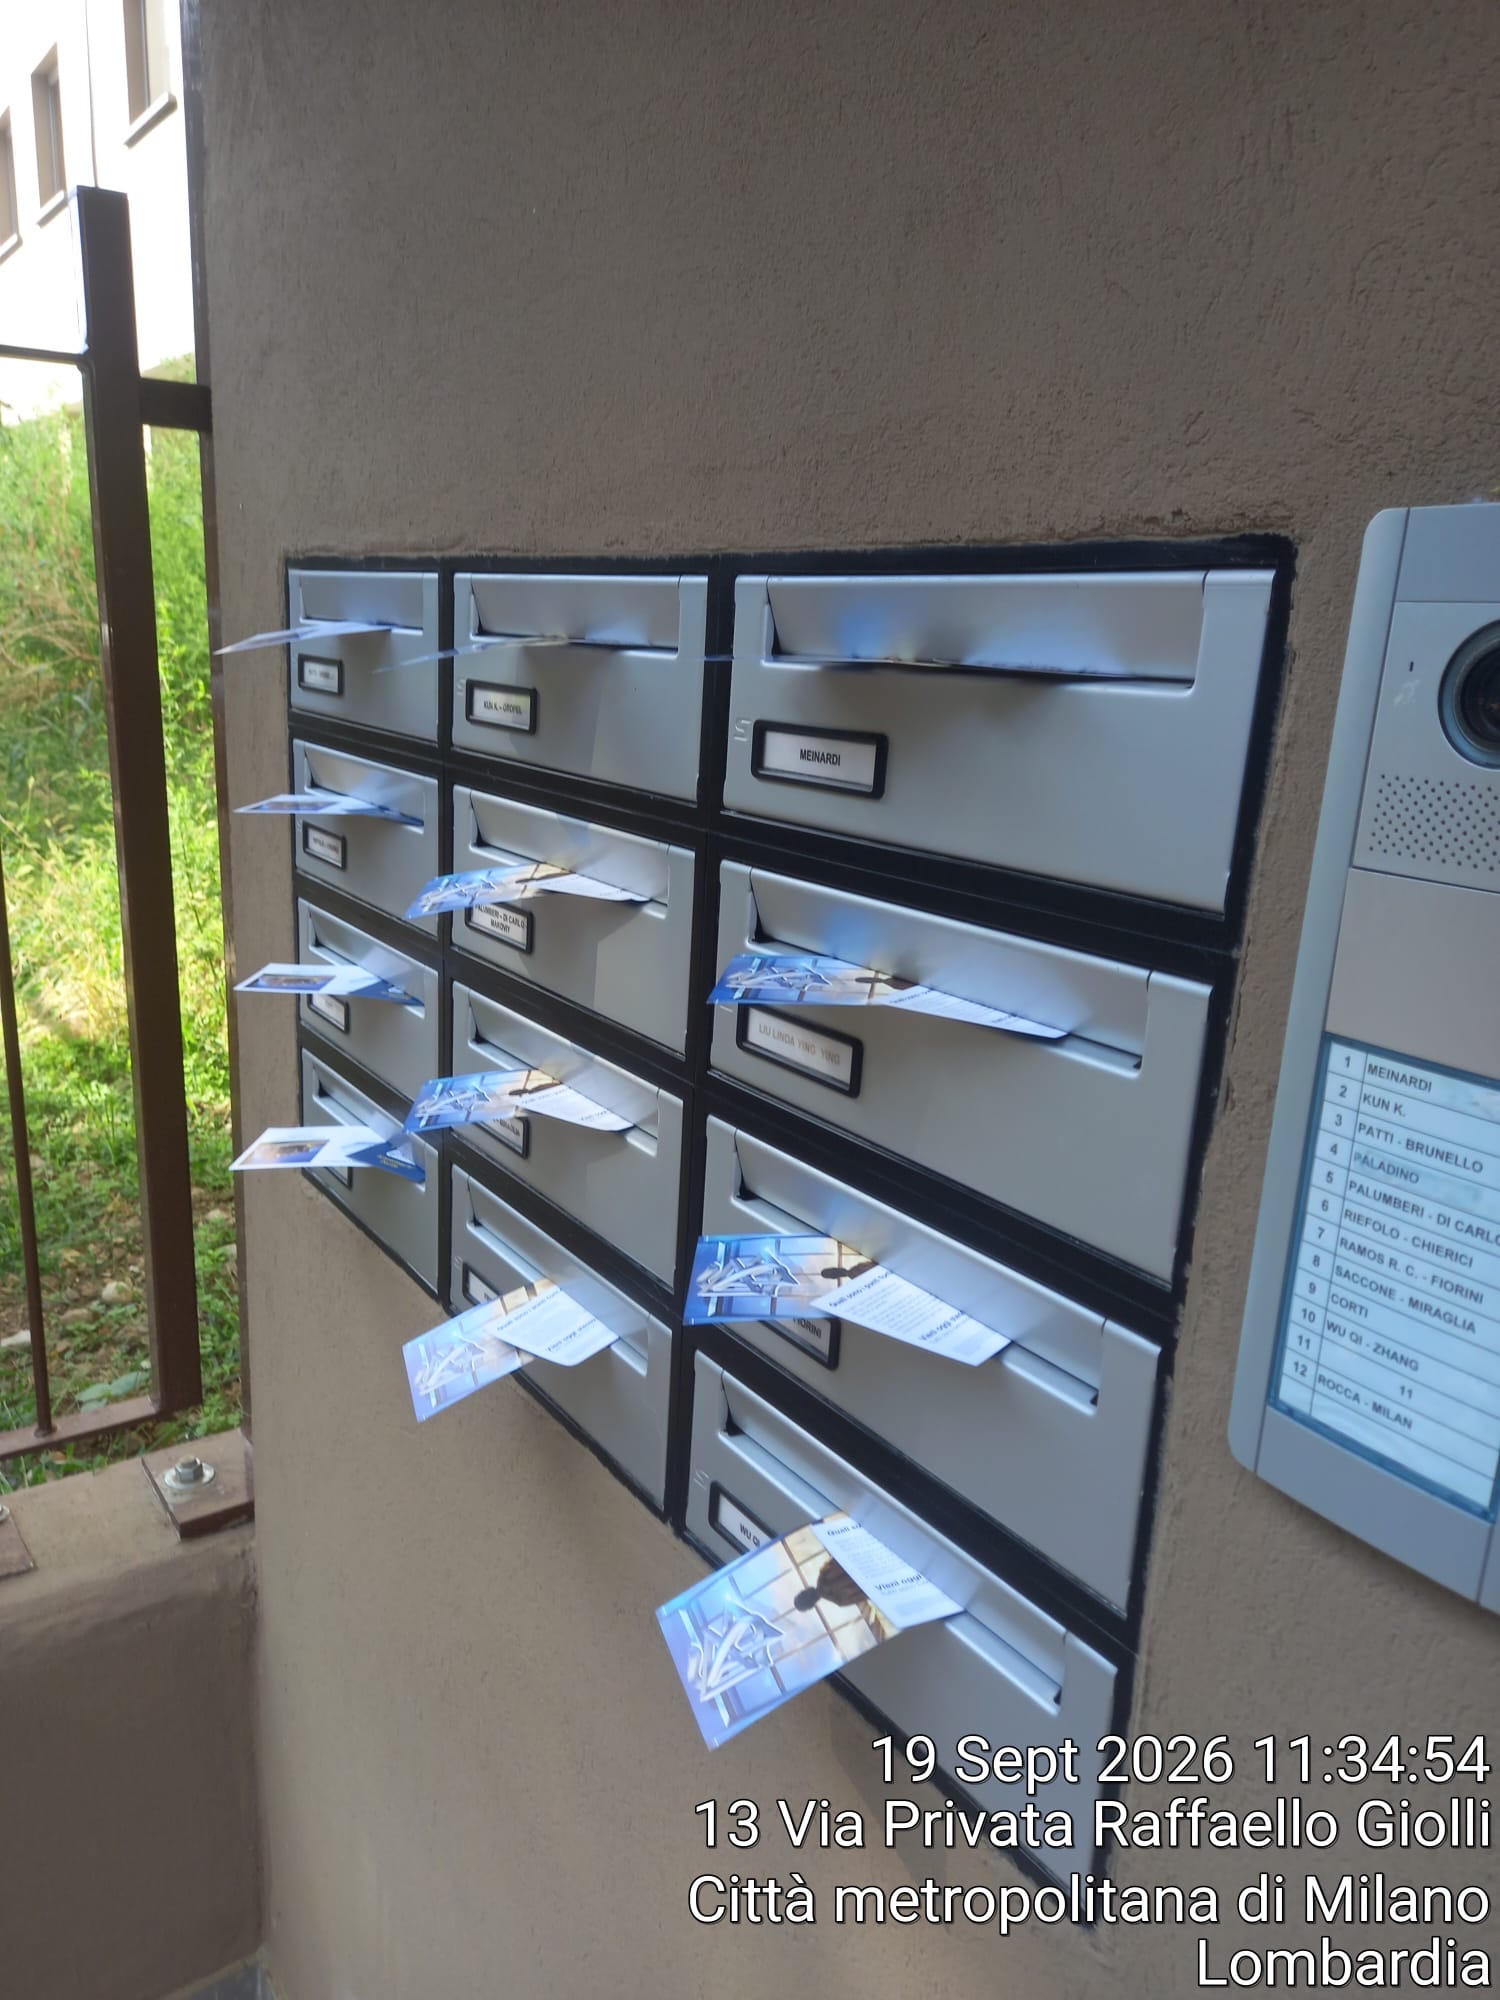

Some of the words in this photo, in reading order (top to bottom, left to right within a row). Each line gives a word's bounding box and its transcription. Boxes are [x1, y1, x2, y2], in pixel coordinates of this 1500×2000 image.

[799, 748, 841, 767] MEINARDI
[772, 1027, 795, 1046] LINDA
[1344, 1055, 1351, 1068] 1
[1367, 1063, 1432, 1093] MEINARDI
[1338, 1085, 1347, 1098] 2
[1362, 1093, 1390, 1112] KUN
[1393, 1103, 1406, 1117] K.
[1330, 1143, 1338, 1156] 4
[1353, 1151, 1420, 1184] PALADINO
[1334, 1114, 1342, 1127] 3
[1358, 1122, 1394, 1145] PATTI
[1405, 1138, 1484, 1174] BRUNELLO
[1325, 1171, 1334, 1184] 5
[1348, 1180, 1425, 1219] PALUMBERI
[1436, 1212, 1451, 1228] DI
[1321, 1199, 1329, 1213] 6
[1343, 1208, 1400, 1239] RIEFOLO
[1411, 1235, 1474, 1268] CHIERICI
[1316, 1226, 1325, 1240] 7
[1339, 1237, 1385, 1265] RAMOS
[1430, 1274, 1484, 1305] FIORINI
[1308, 1281, 1316, 1295] 9
[1330, 1293, 1369, 1319] CORTI
[1312, 1254, 1320, 1268] 8
[1334, 1264, 1397, 1300] SACCONE
[1408, 1296, 1477, 1335] MIRAGLIA
[1297, 1334, 1310, 1350] 11
[1301, 1307, 1316, 1324] 10
[1326, 1319, 1346, 1337] WU
[1349, 1331, 1363, 1346] QI
[1372, 1342, 1419, 1372] ZHANG
[1293, 1361, 1308, 1377] 12
[1317, 1373, 1361, 1404] ROCCA
[1371, 1401, 1413, 1430] MILAN
[1399, 1384, 1413, 1399] 11
[739, 1523, 752, 1539] WU
